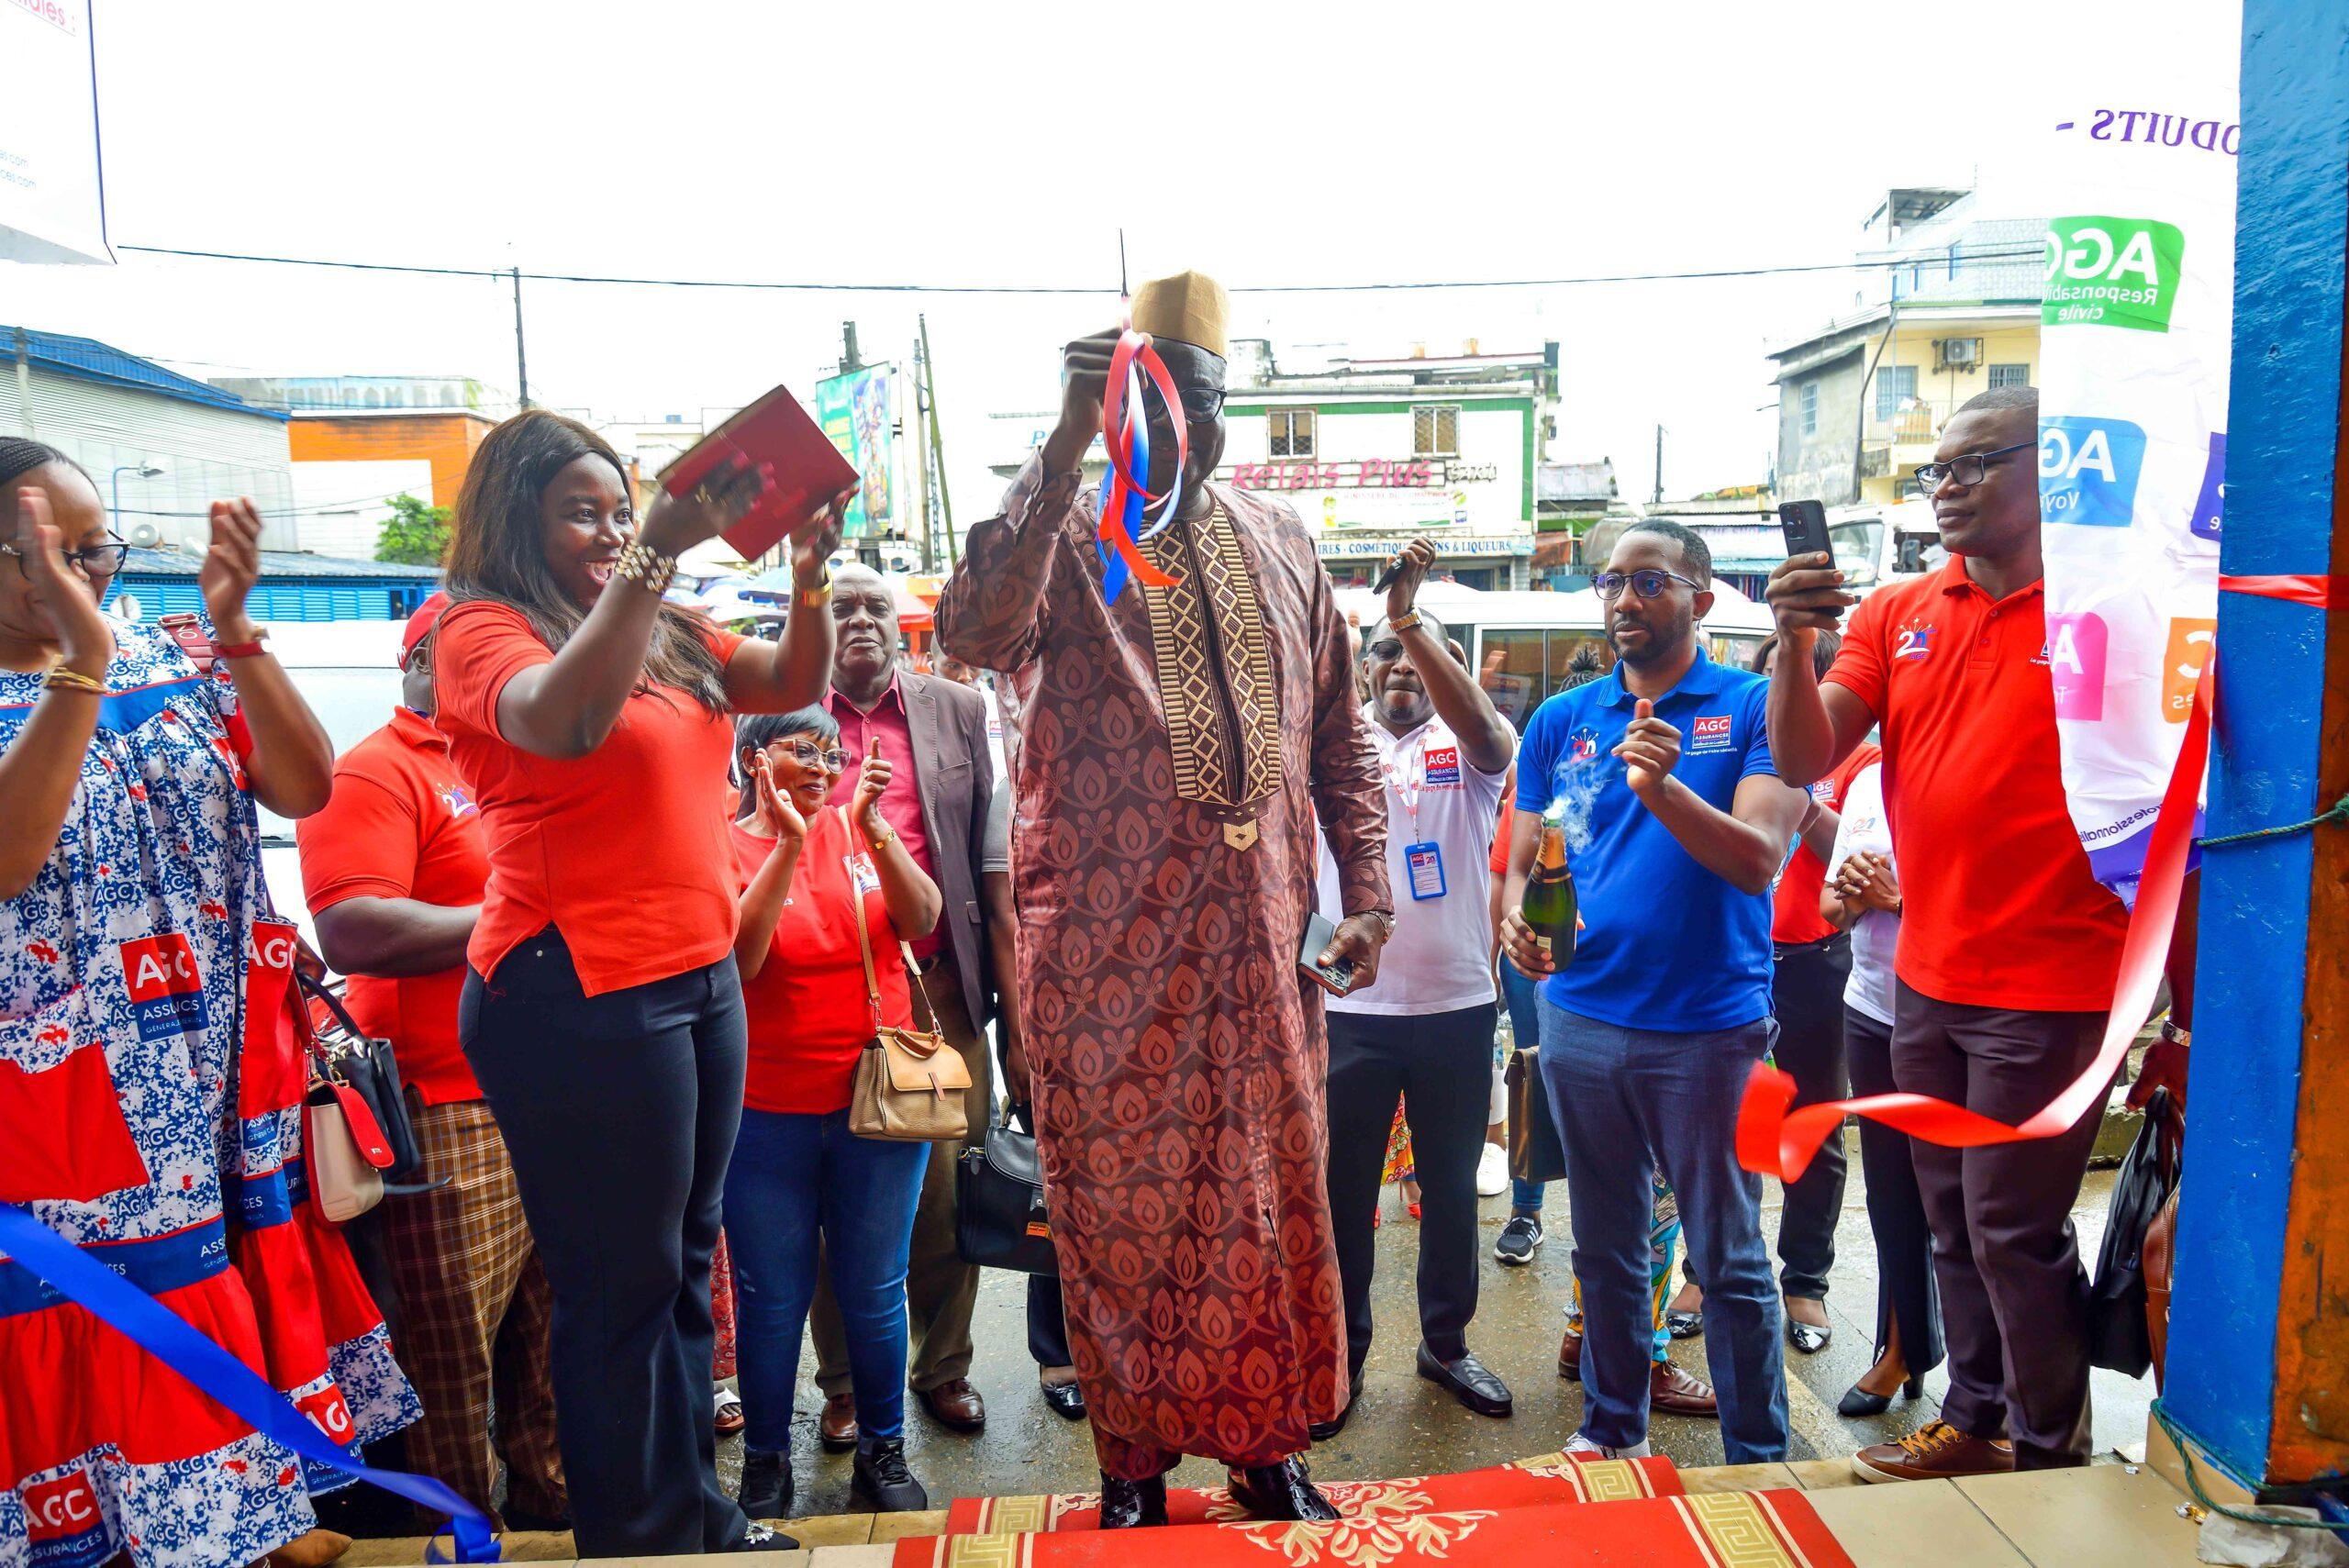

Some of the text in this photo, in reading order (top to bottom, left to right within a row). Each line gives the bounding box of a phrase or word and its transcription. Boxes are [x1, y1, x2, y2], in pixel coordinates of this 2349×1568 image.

[1231, 459, 1432, 491] Relais Plus
[1462, 541, 1511, 552] LIQUEURS
[1696, 718, 1730, 732] AGC
[1427, 751, 1456, 766] AGC
[1427, 767, 1458, 776] ASSURANCES
[94, 883, 135, 906] AGC
[140, 1124, 182, 1151] AGC
[169, 1454, 204, 1475] AGC
[242, 1485, 279, 1517] AGC
[148, 1522, 177, 1543] AGC
